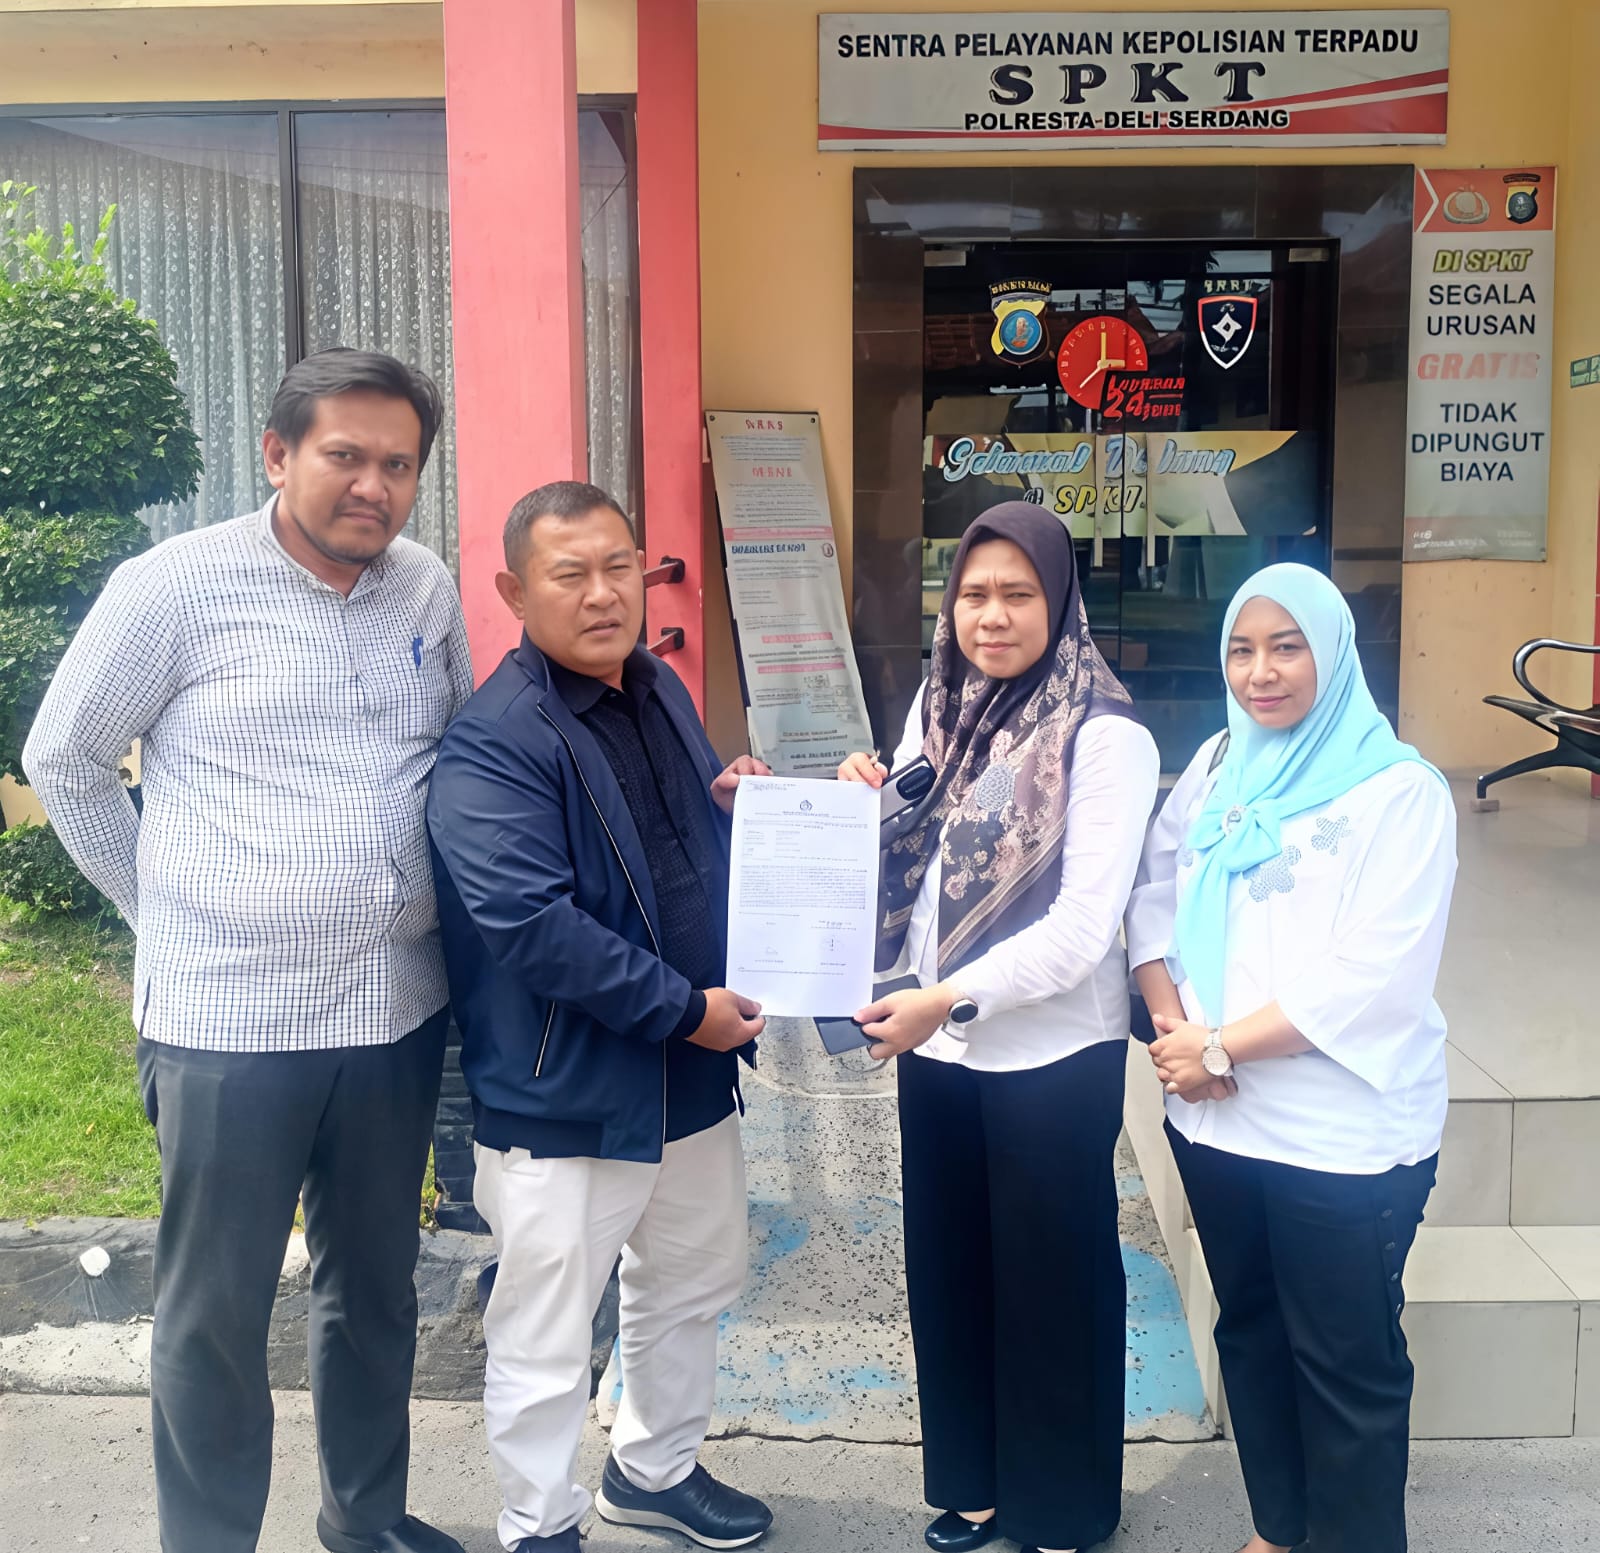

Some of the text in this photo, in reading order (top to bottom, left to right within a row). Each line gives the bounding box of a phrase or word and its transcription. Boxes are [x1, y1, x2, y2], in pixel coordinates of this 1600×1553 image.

[838, 30, 1418, 57] SENTRA PELAYANAN KEPOLISIAN TERPADU
[1103, 111, 1161, 130] DELI
[1168, 109, 1290, 129] SERDANG
[1433, 248, 1533, 273] DI SPKT
[1428, 284, 1536, 305] SEGALA
[1427, 314, 1536, 336] URUSAN
[1417, 353, 1541, 380] GRATIS
[1440, 402, 1517, 423] TIDAK
[1411, 432, 1545, 453] DIPUNGUT
[1440, 462, 1514, 482] BIAYA
